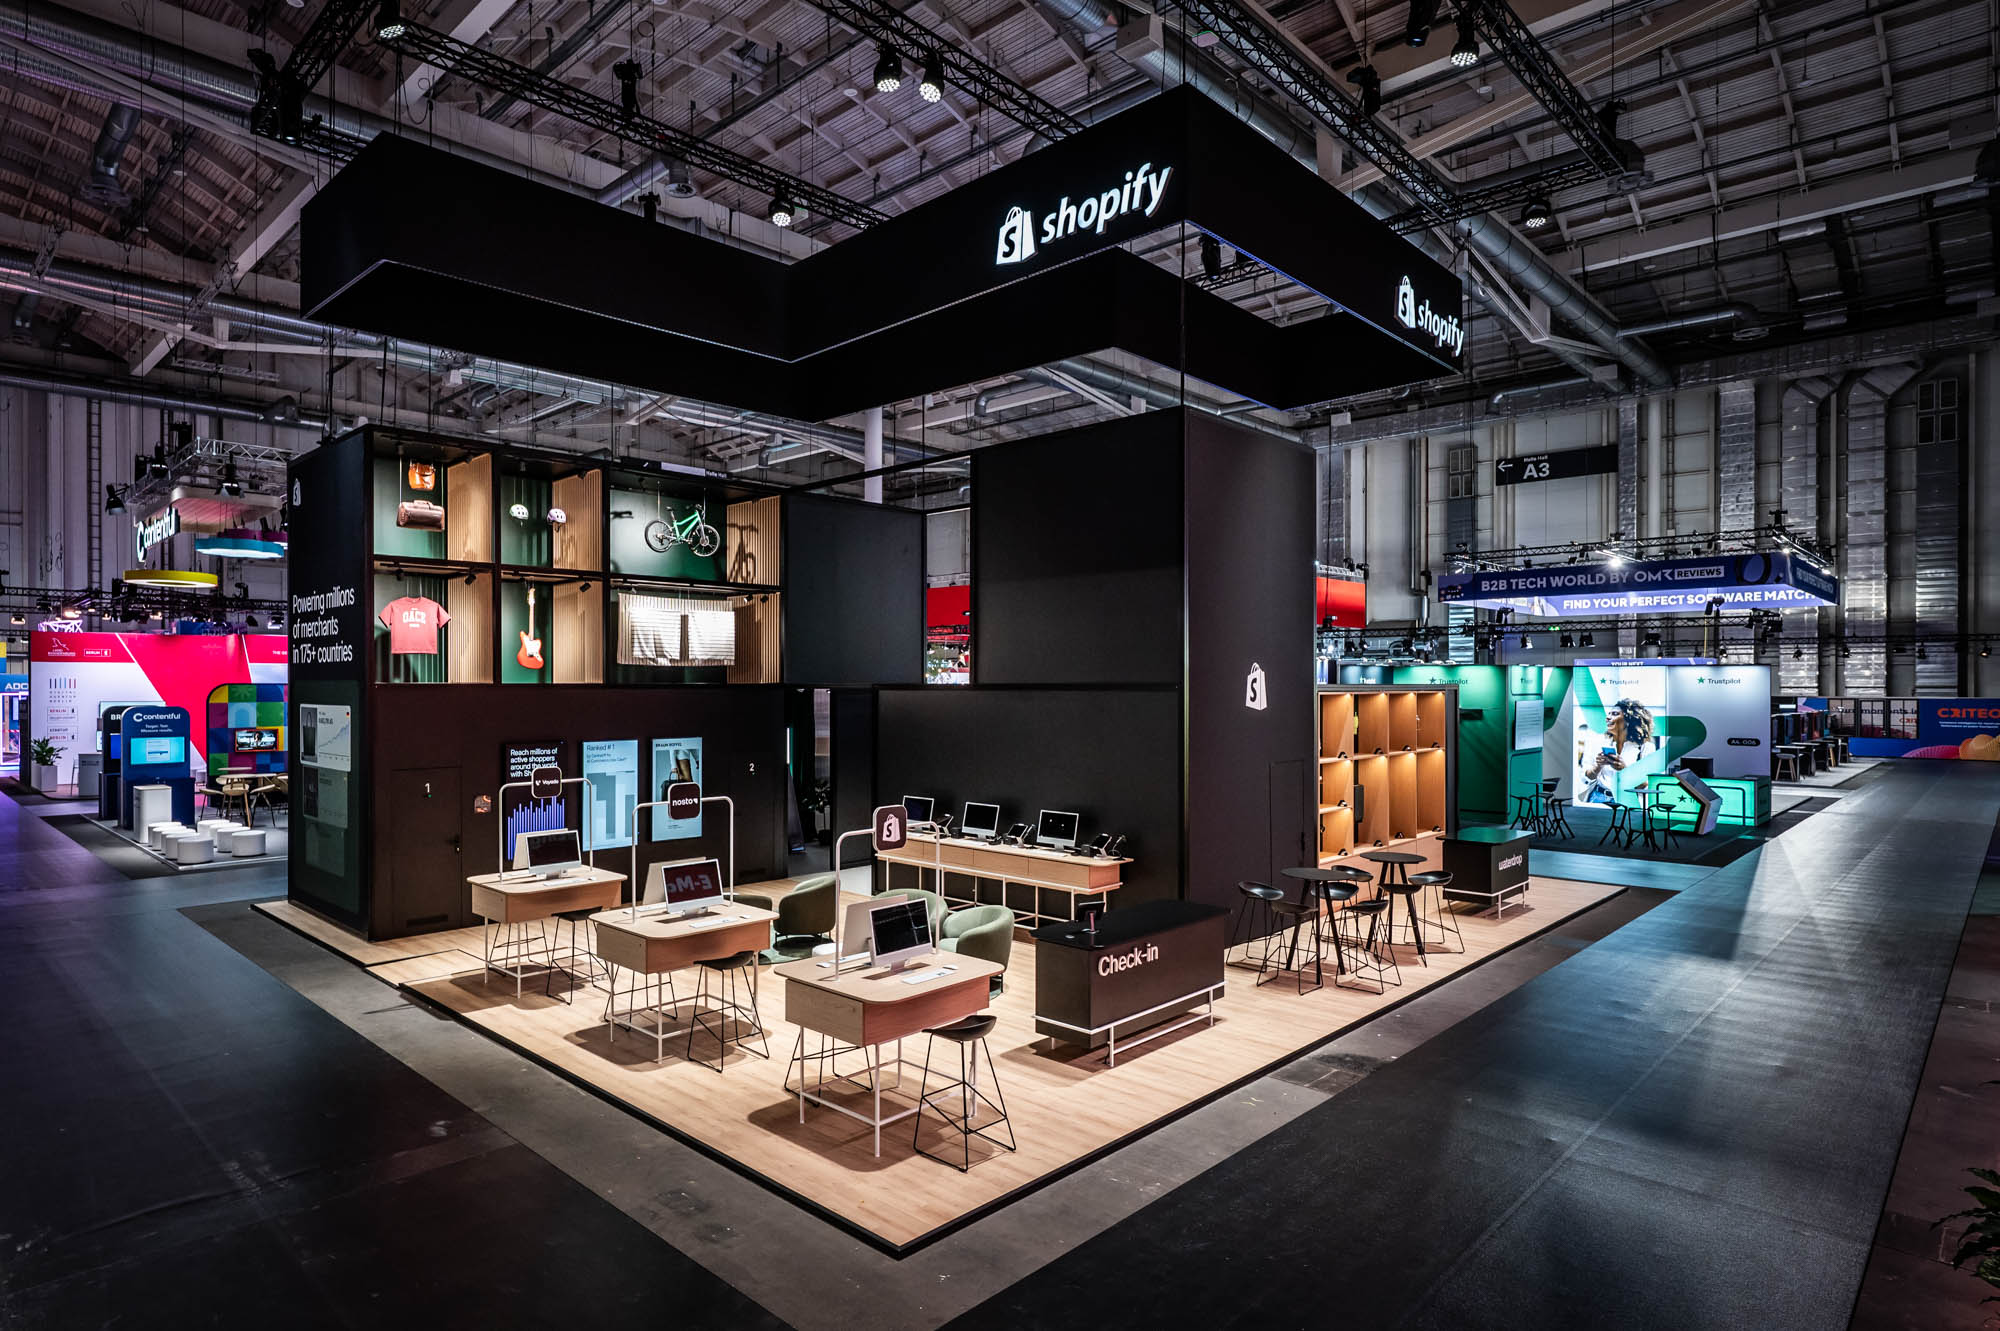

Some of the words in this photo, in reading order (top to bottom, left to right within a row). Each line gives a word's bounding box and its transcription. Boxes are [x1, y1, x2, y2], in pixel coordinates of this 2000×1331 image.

[1040, 162, 1172, 244] shopify
[1417, 299, 1464, 357] shopify
[1523, 462, 1550, 480] A3
[1481, 580, 1508, 591] B2B
[1510, 577, 1547, 590] TECH
[1550, 573, 1606, 587] WORLD
[1609, 572, 1629, 584] BY
[1676, 568, 1722, 578] REVIEWS
[292, 590, 325, 615] Powering
[326, 585, 355, 609] millions
[1563, 600, 1591, 609] FIND
[1593, 598, 1627, 608] YOUR
[1630, 594, 1684, 607] PERFECT
[292, 618, 301, 639] of
[301, 616, 339, 638] merchants
[293, 643, 299, 664] in
[300, 643, 316, 664] 175+
[317, 640, 353, 663] countries
[143, 712, 181, 720] contentful
[510, 749, 529, 757] Reach
[529, 755, 555, 764] shoppers
[510, 763, 531, 771] around
[750, 763, 755, 772] 2
[424, 783, 430, 793] 1
[672, 798, 693, 806] nosto
[1098, 943, 1160, 977] Check-in
